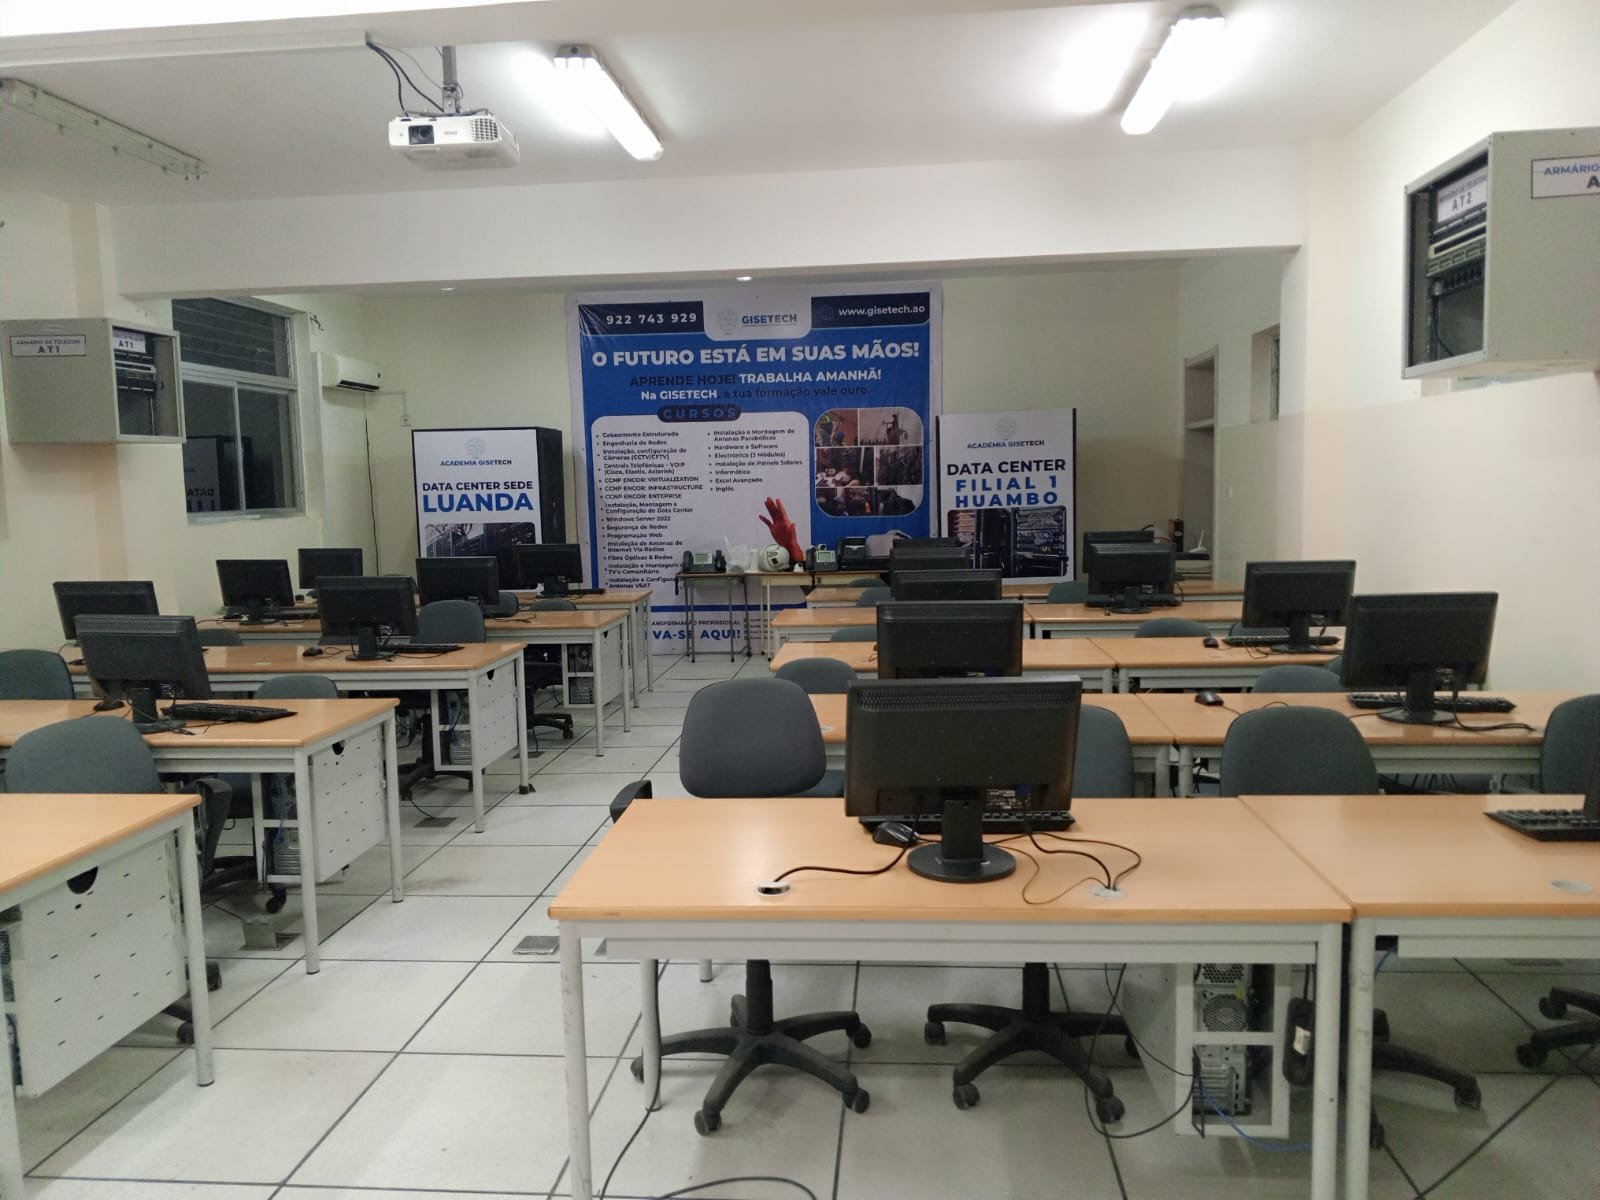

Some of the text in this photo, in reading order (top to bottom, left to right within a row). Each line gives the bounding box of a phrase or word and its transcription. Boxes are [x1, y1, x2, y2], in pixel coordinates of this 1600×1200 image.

[838, 305, 926, 317] www.gisetech.ao
[606, 313, 697, 324] 922 743 929
[742, 314, 798, 324] GISETECH
[592, 339, 920, 366] O FUTURO ESTÁ EM SUAS MÃOS!
[630, 369, 881, 387] APRENDE HOJE! TRABALHA AMANHÃ!
[641, 391, 656, 400] Na
[733, 389, 752, 398] tua
[756, 386, 810, 399] formação
[814, 386, 837, 396] vale
[663, 408, 736, 419] CURSOS
[947, 459, 1066, 476] DATA CENTER
[423, 481, 533, 491] DATA CENTER SEDE
[956, 476, 1057, 492] FILIAL 1
[423, 493, 534, 513] LUANDA
[955, 492, 1058, 508] HUAMBO
[700, 630, 740, 640] AQUI!
